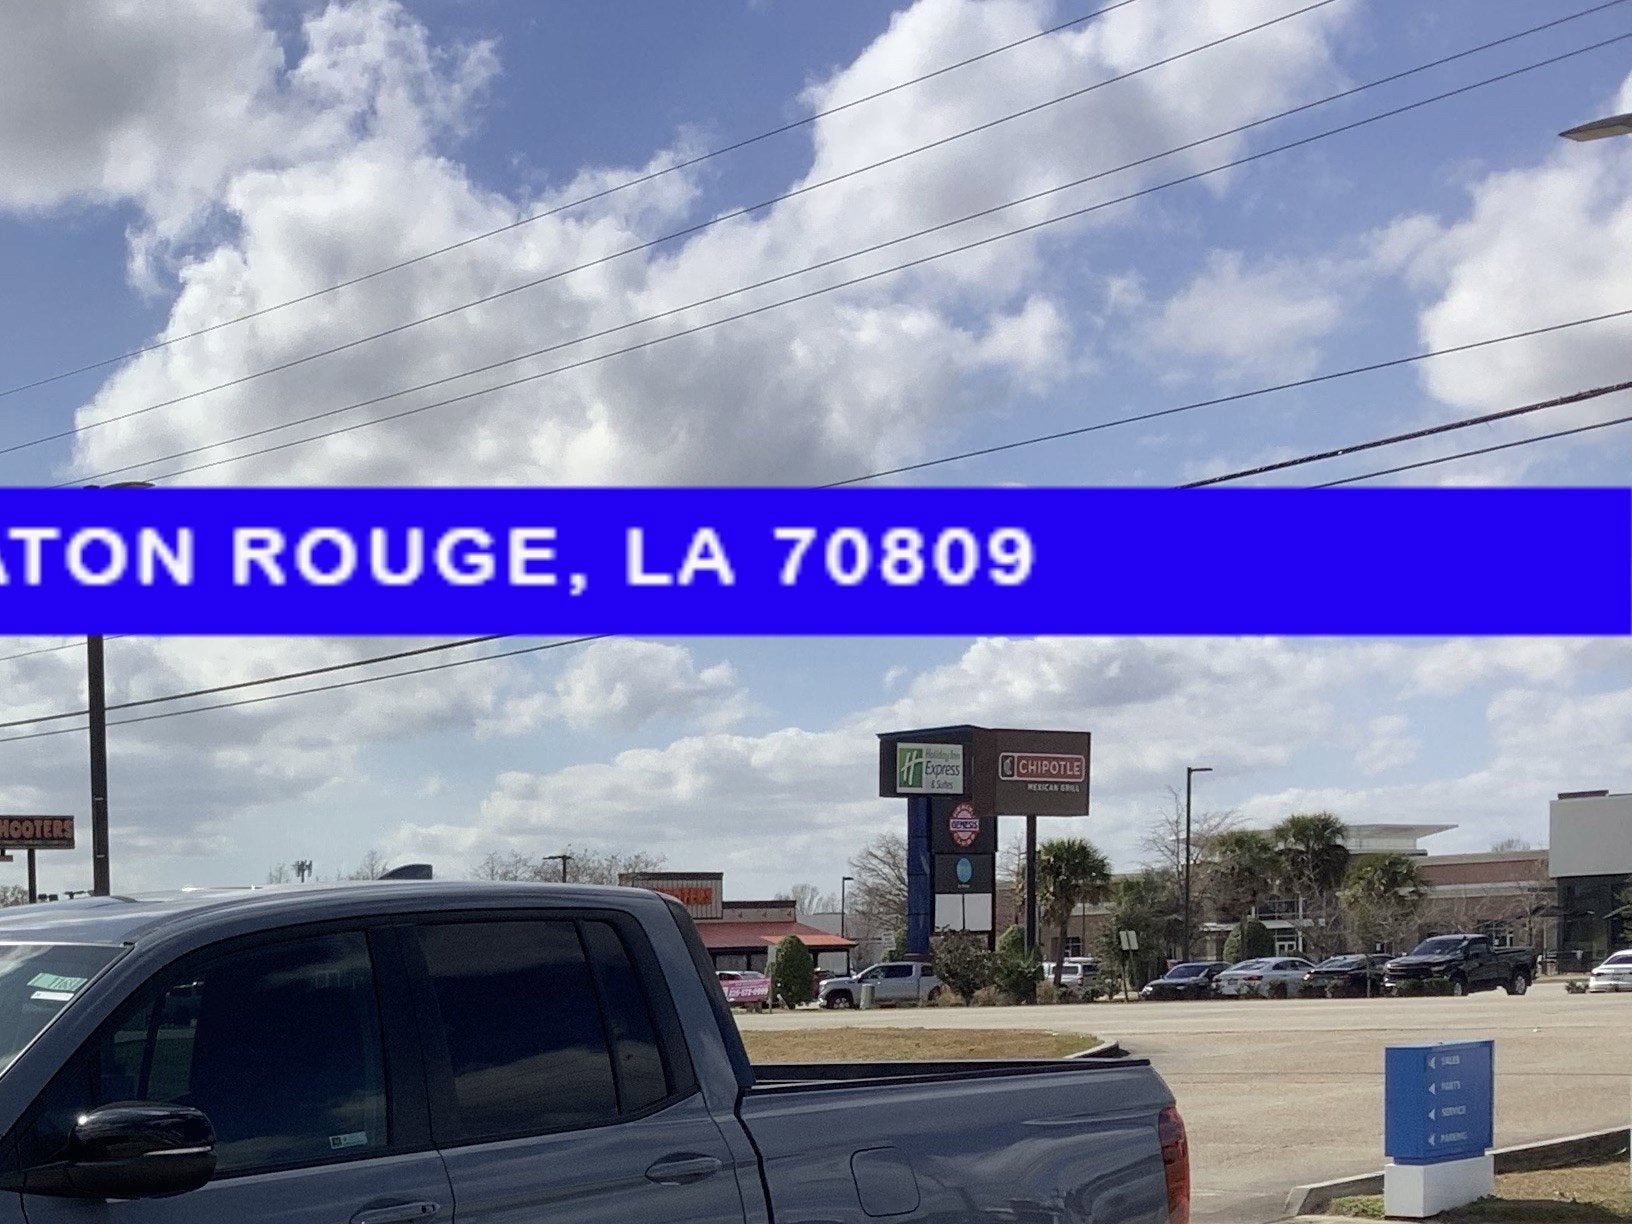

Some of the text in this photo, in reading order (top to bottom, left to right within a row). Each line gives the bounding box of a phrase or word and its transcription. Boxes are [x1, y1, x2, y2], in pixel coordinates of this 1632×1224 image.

[924, 761, 960, 779] Express
[1018, 758, 1082, 776] CHIPOTLE
[1027, 783, 1080, 793] MEXICAN GRILL
